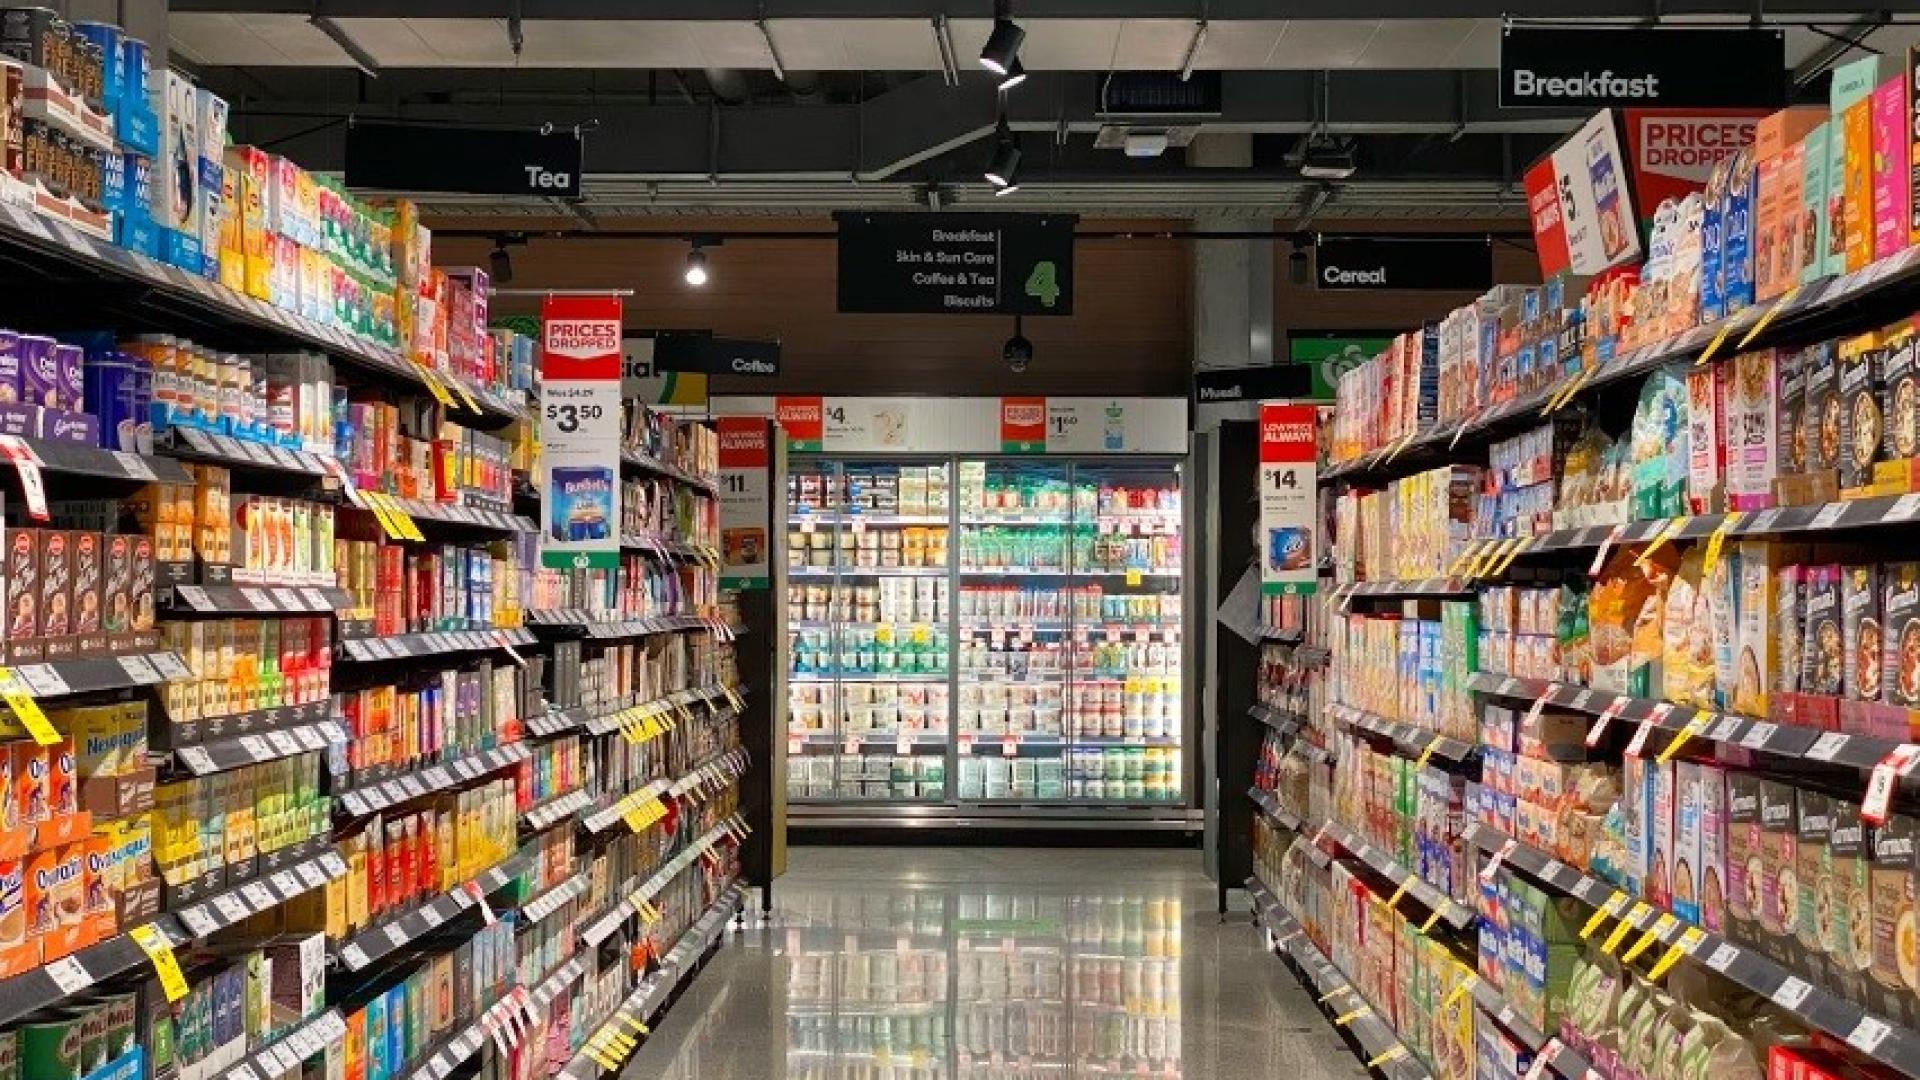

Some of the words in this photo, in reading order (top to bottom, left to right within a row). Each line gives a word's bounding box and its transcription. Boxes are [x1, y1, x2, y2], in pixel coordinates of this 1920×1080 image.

[1513, 69, 1660, 98] Breakfast
[1646, 123, 1757, 147] PRICES
[1646, 148, 1738, 166] DROPP
[524, 166, 569, 188] Tea
[932, 229, 995, 242] Breakfast
[936, 252, 961, 264] Sun
[963, 252, 995, 265] Care
[912, 272, 955, 285] Coffee
[969, 272, 995, 285] Tea
[1324, 265, 1387, 285] Cereal
[1024, 260, 1060, 308] 4
[549, 323, 617, 337] PRICES
[549, 337, 617, 350] DROPPED
[731, 358, 775, 373] Coffee
